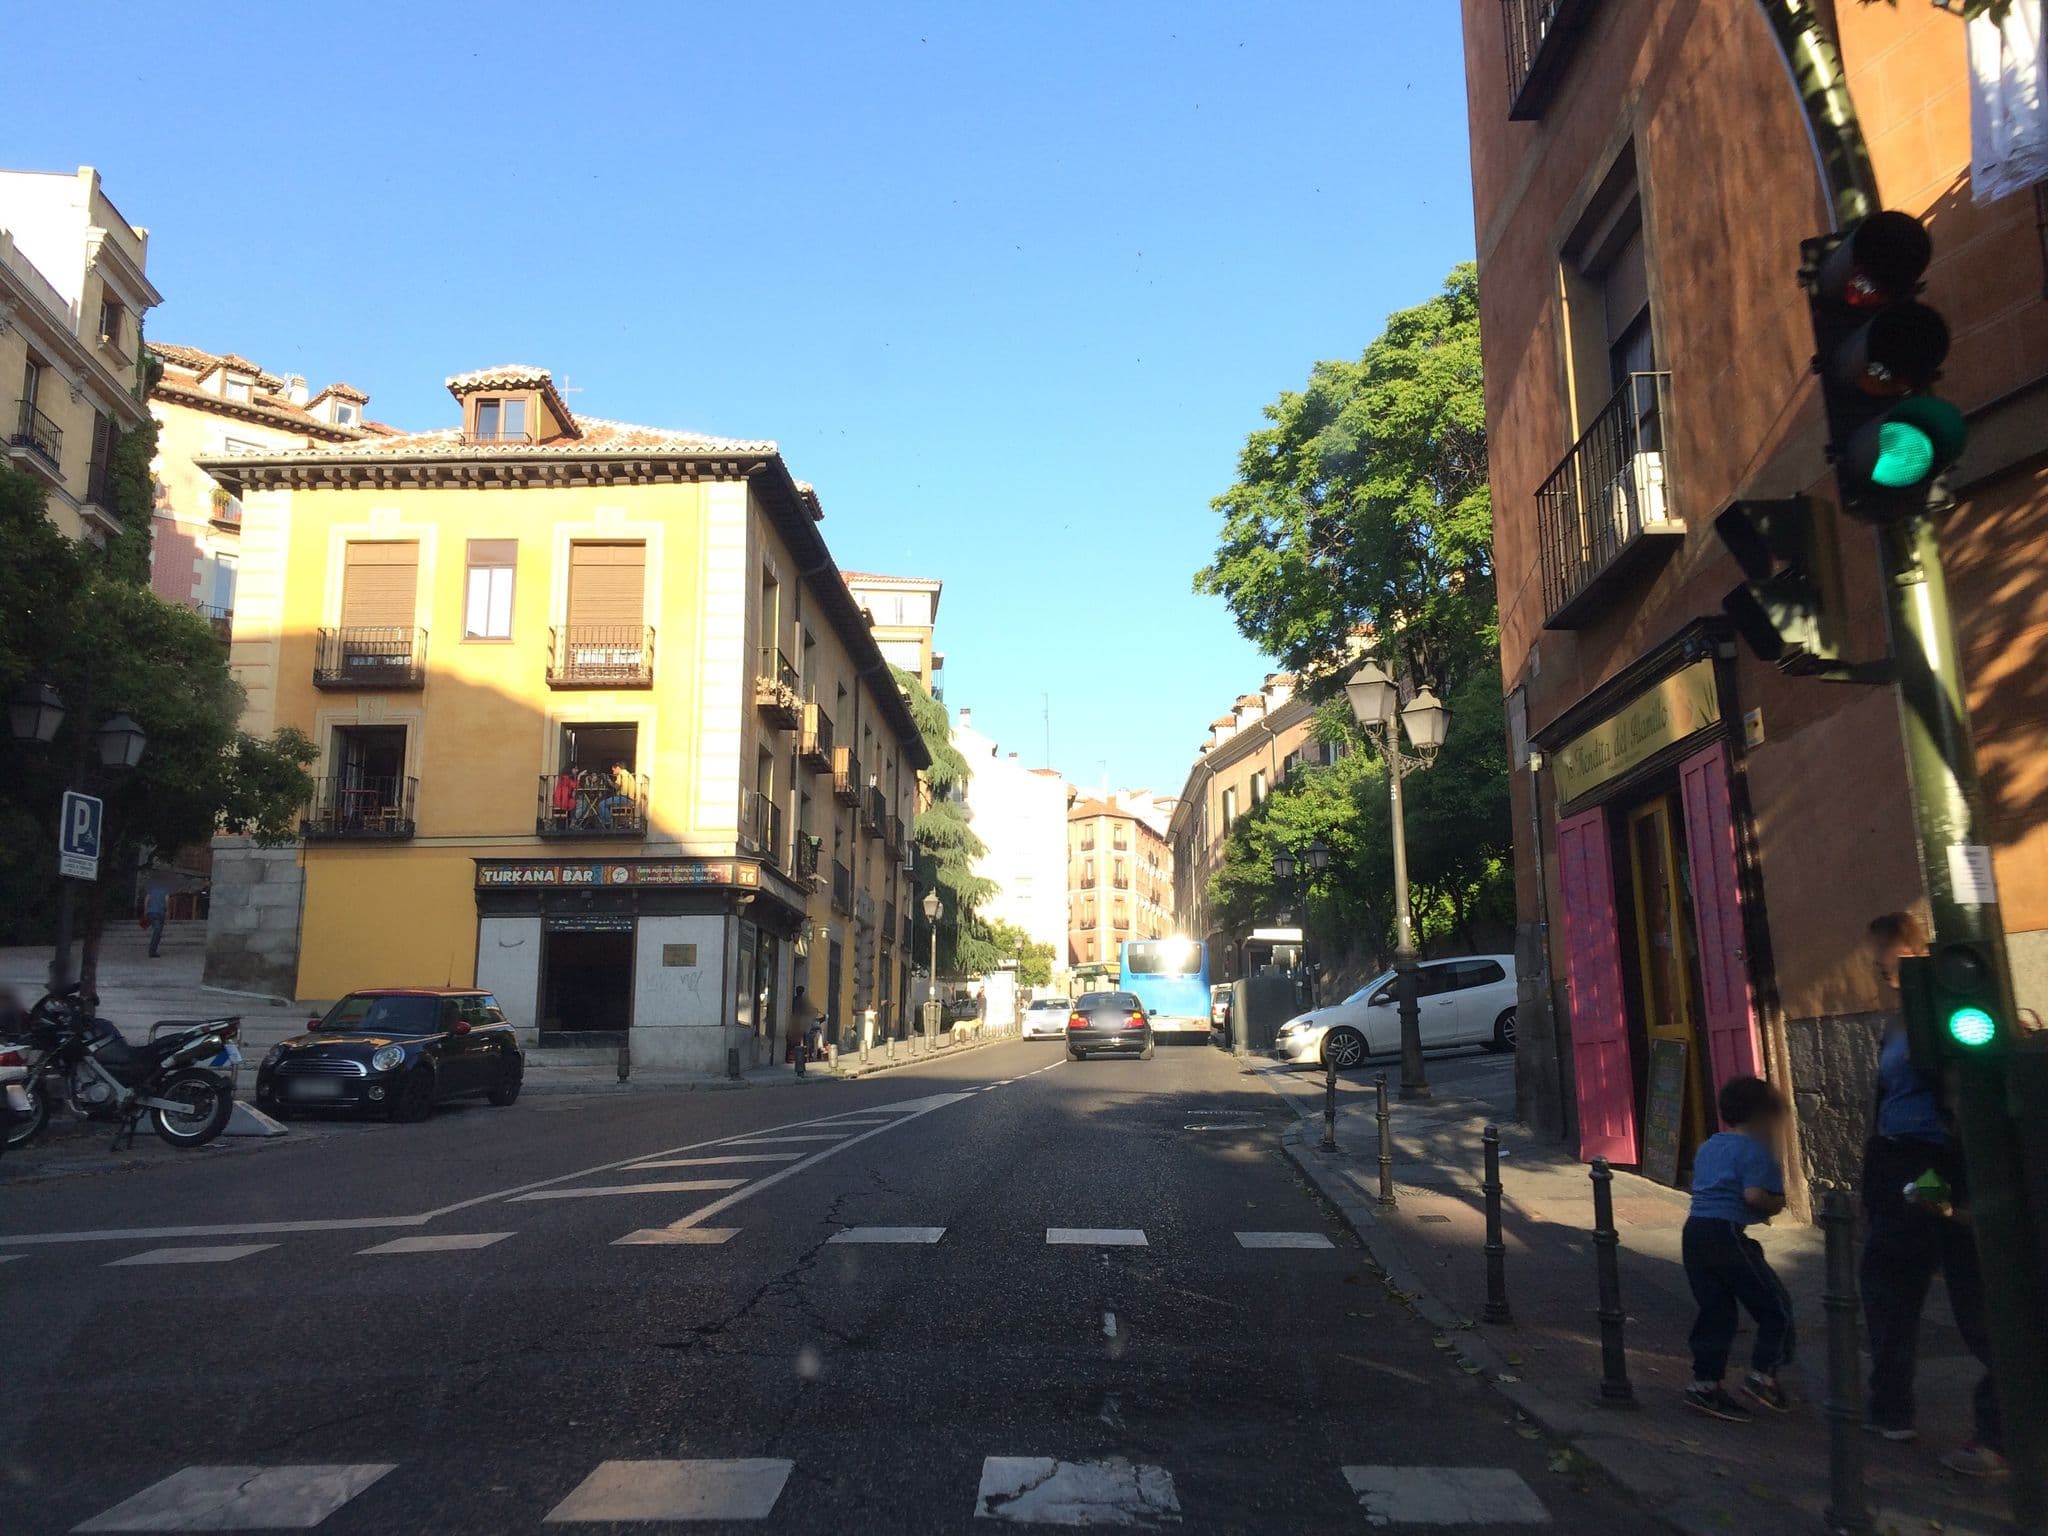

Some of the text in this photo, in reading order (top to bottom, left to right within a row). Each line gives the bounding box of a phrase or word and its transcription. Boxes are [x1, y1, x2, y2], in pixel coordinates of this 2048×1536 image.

[72, 800, 91, 847] P
[484, 870, 593, 882] TURKANA BAR
